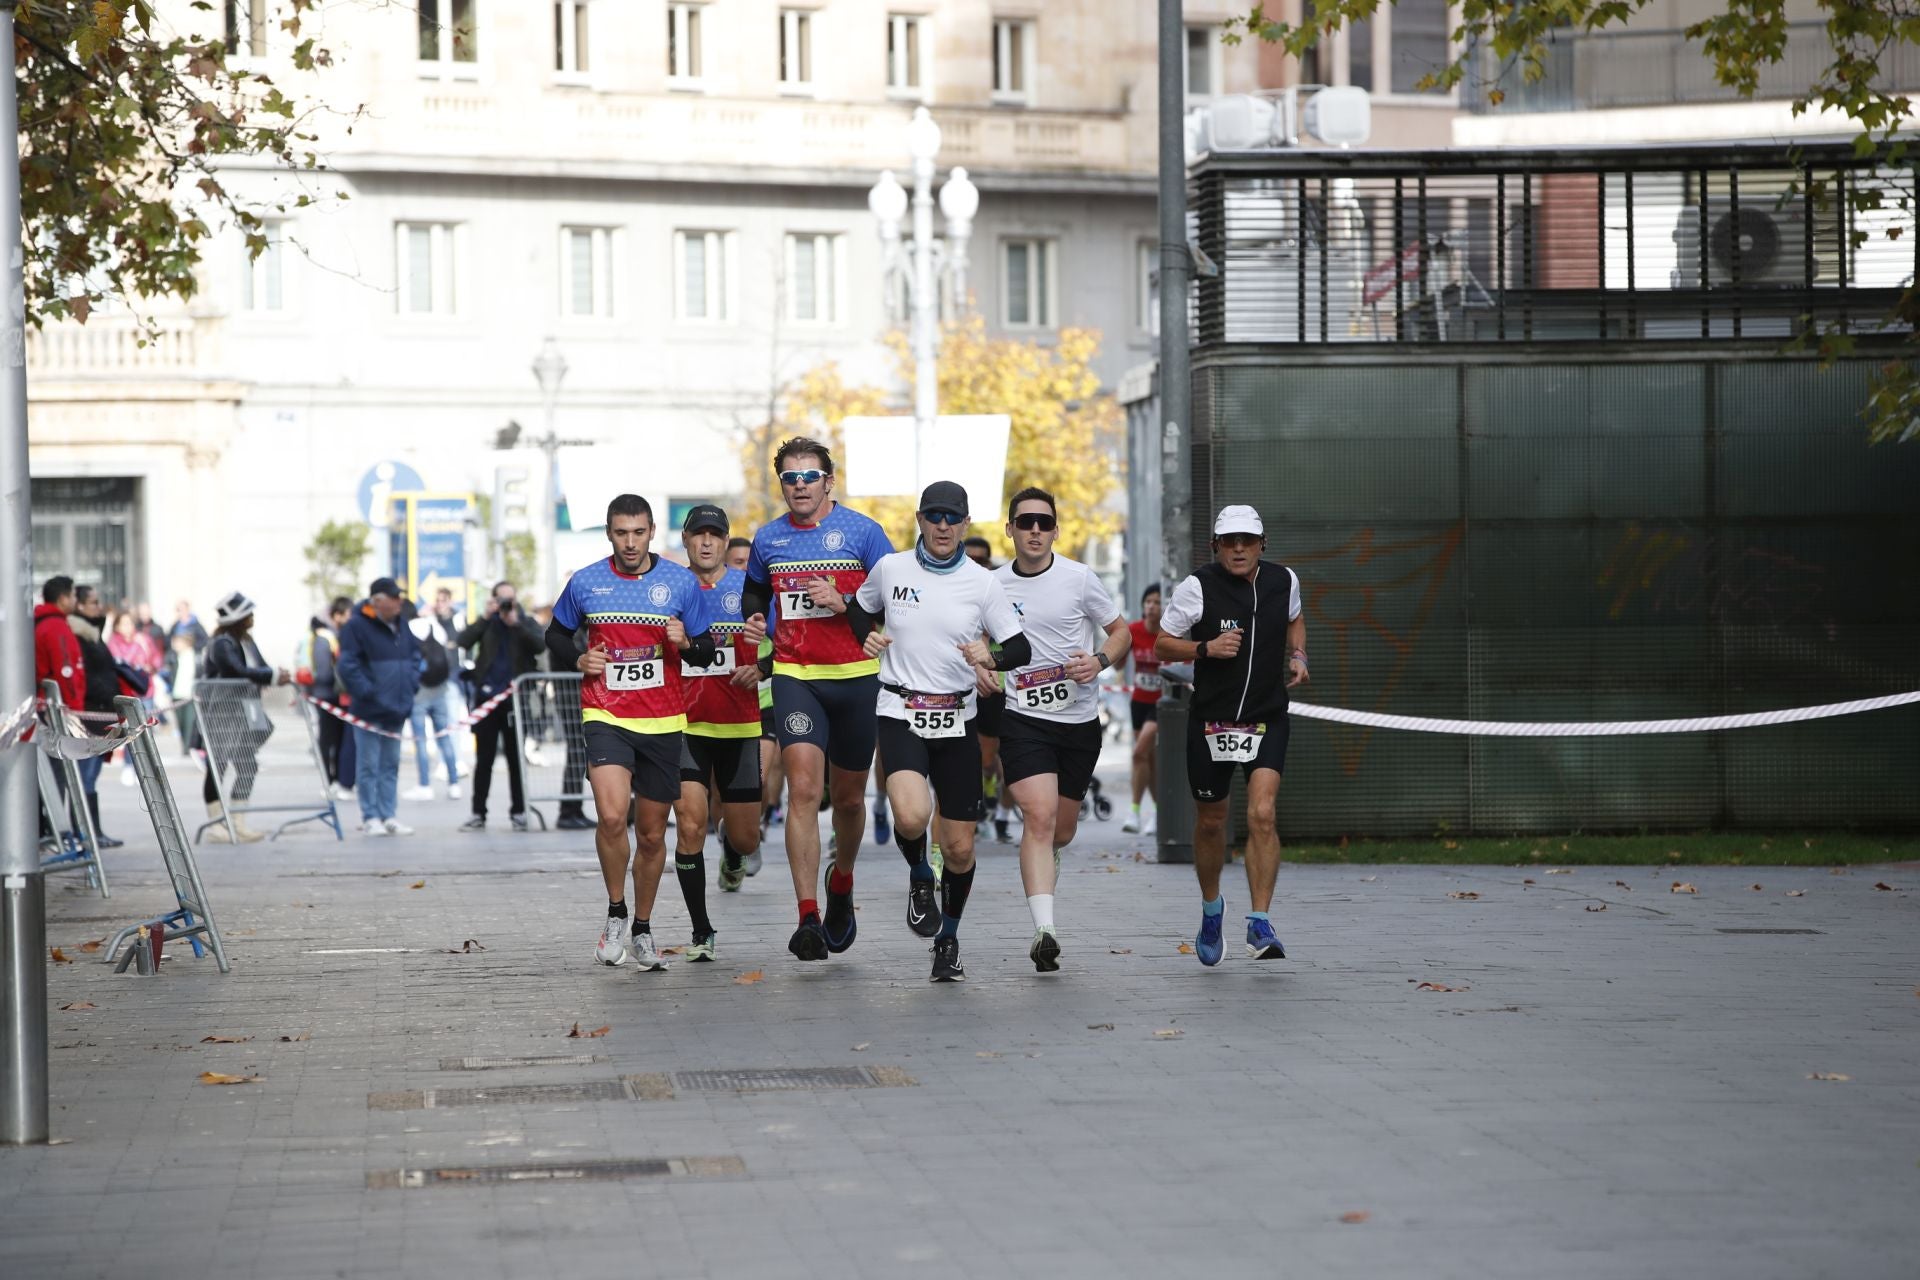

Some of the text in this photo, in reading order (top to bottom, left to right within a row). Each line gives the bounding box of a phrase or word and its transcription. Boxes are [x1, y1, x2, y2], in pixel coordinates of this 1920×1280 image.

[787, 593, 827, 611] 75
[892, 586, 921, 602] MX
[1220, 619, 1239, 629] MX
[613, 662, 655, 682] 758
[1026, 683, 1069, 707] 556
[914, 711, 955, 729] 555
[1216, 734, 1253, 753] 554
